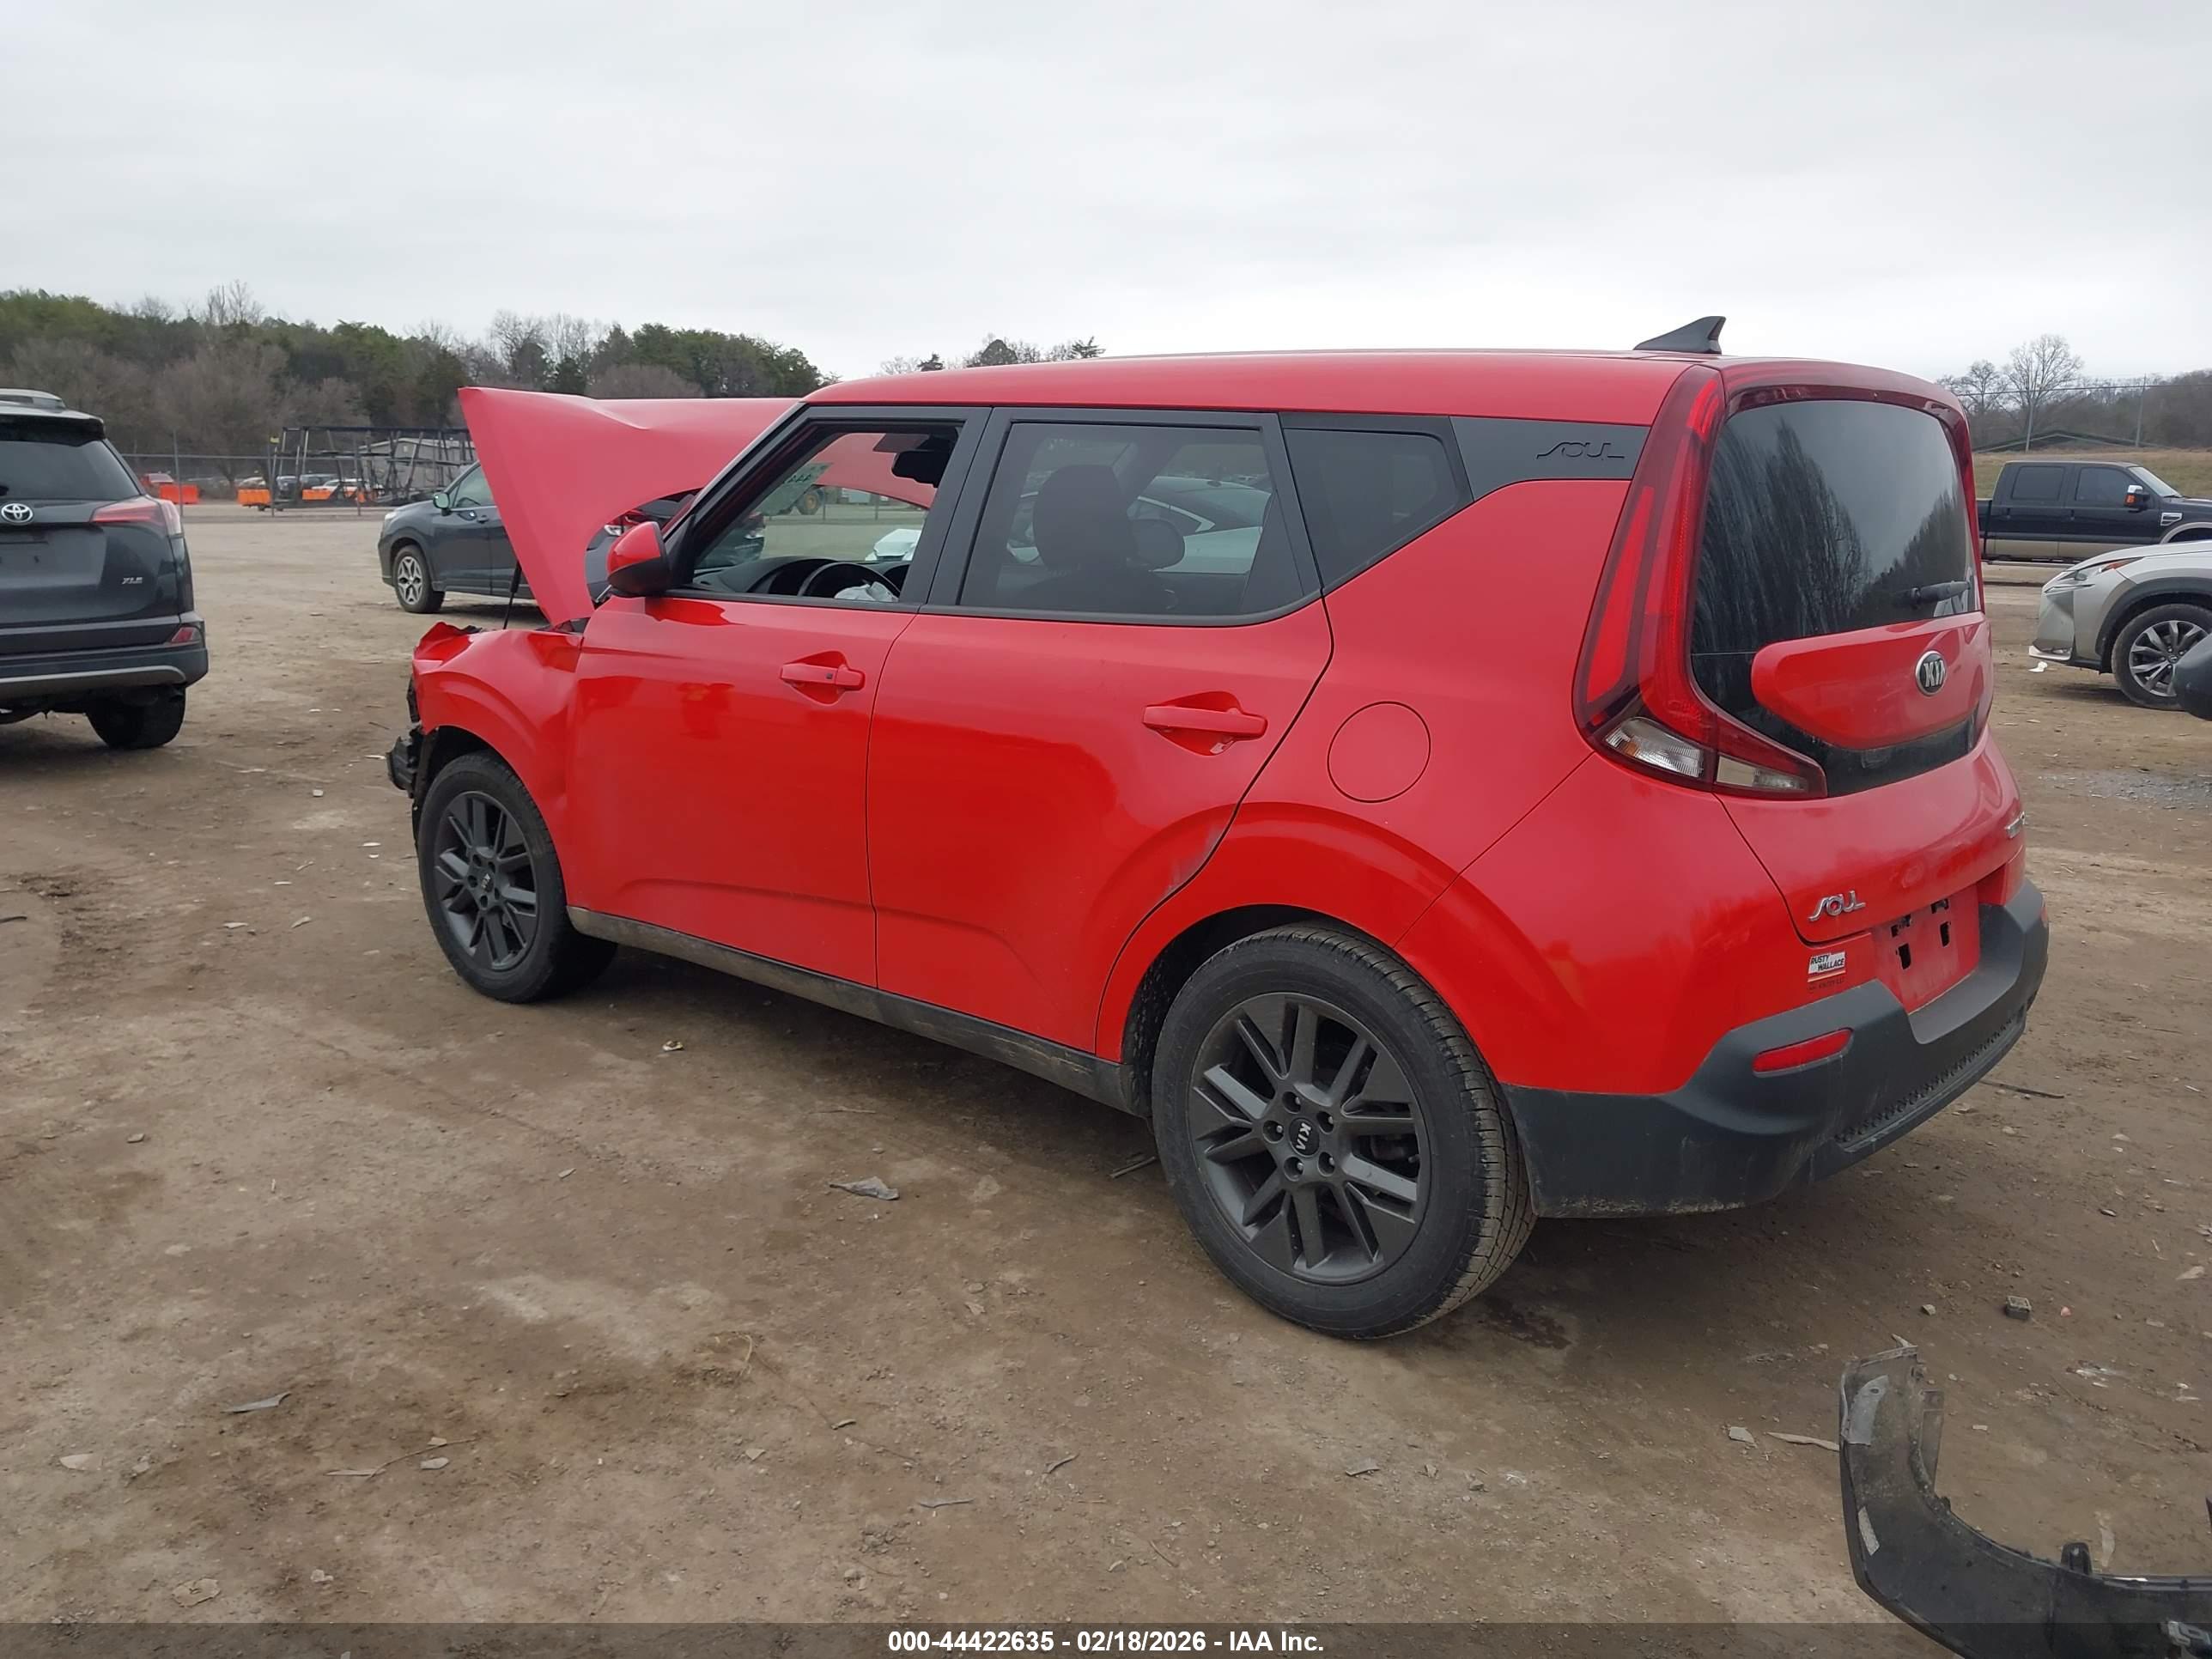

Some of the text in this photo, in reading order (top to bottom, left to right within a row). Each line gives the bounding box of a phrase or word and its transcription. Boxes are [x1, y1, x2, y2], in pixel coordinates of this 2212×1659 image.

[122, 576, 143, 585] XLE
[1923, 659, 1946, 688] KIA
[1808, 890, 1866, 921] SOUL
[1817, 957, 1844, 971] WALLACE
[1295, 1122, 1312, 1150] KIA
